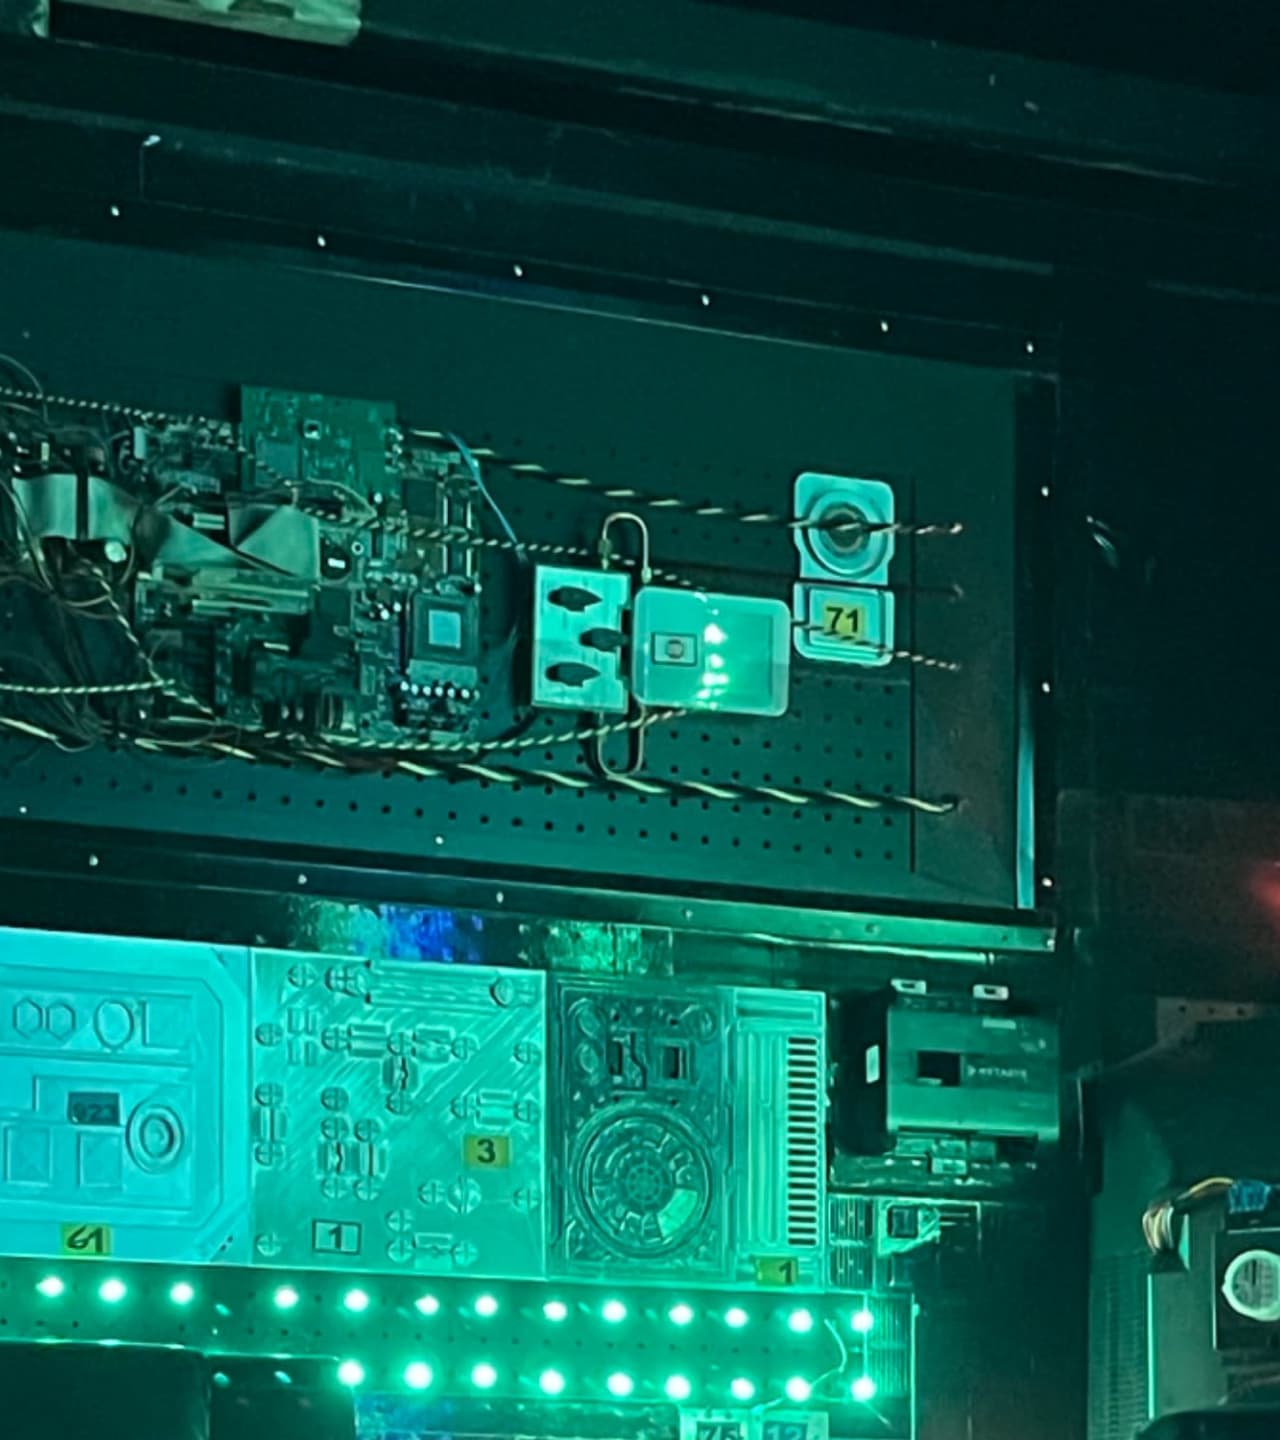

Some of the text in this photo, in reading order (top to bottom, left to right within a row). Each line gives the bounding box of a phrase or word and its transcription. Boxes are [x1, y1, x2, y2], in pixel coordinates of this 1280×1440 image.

[825, 605, 859, 634] 71
[476, 1138, 497, 1164] 3
[66, 1223, 104, 1253] 61
[328, 1224, 343, 1249] 1
